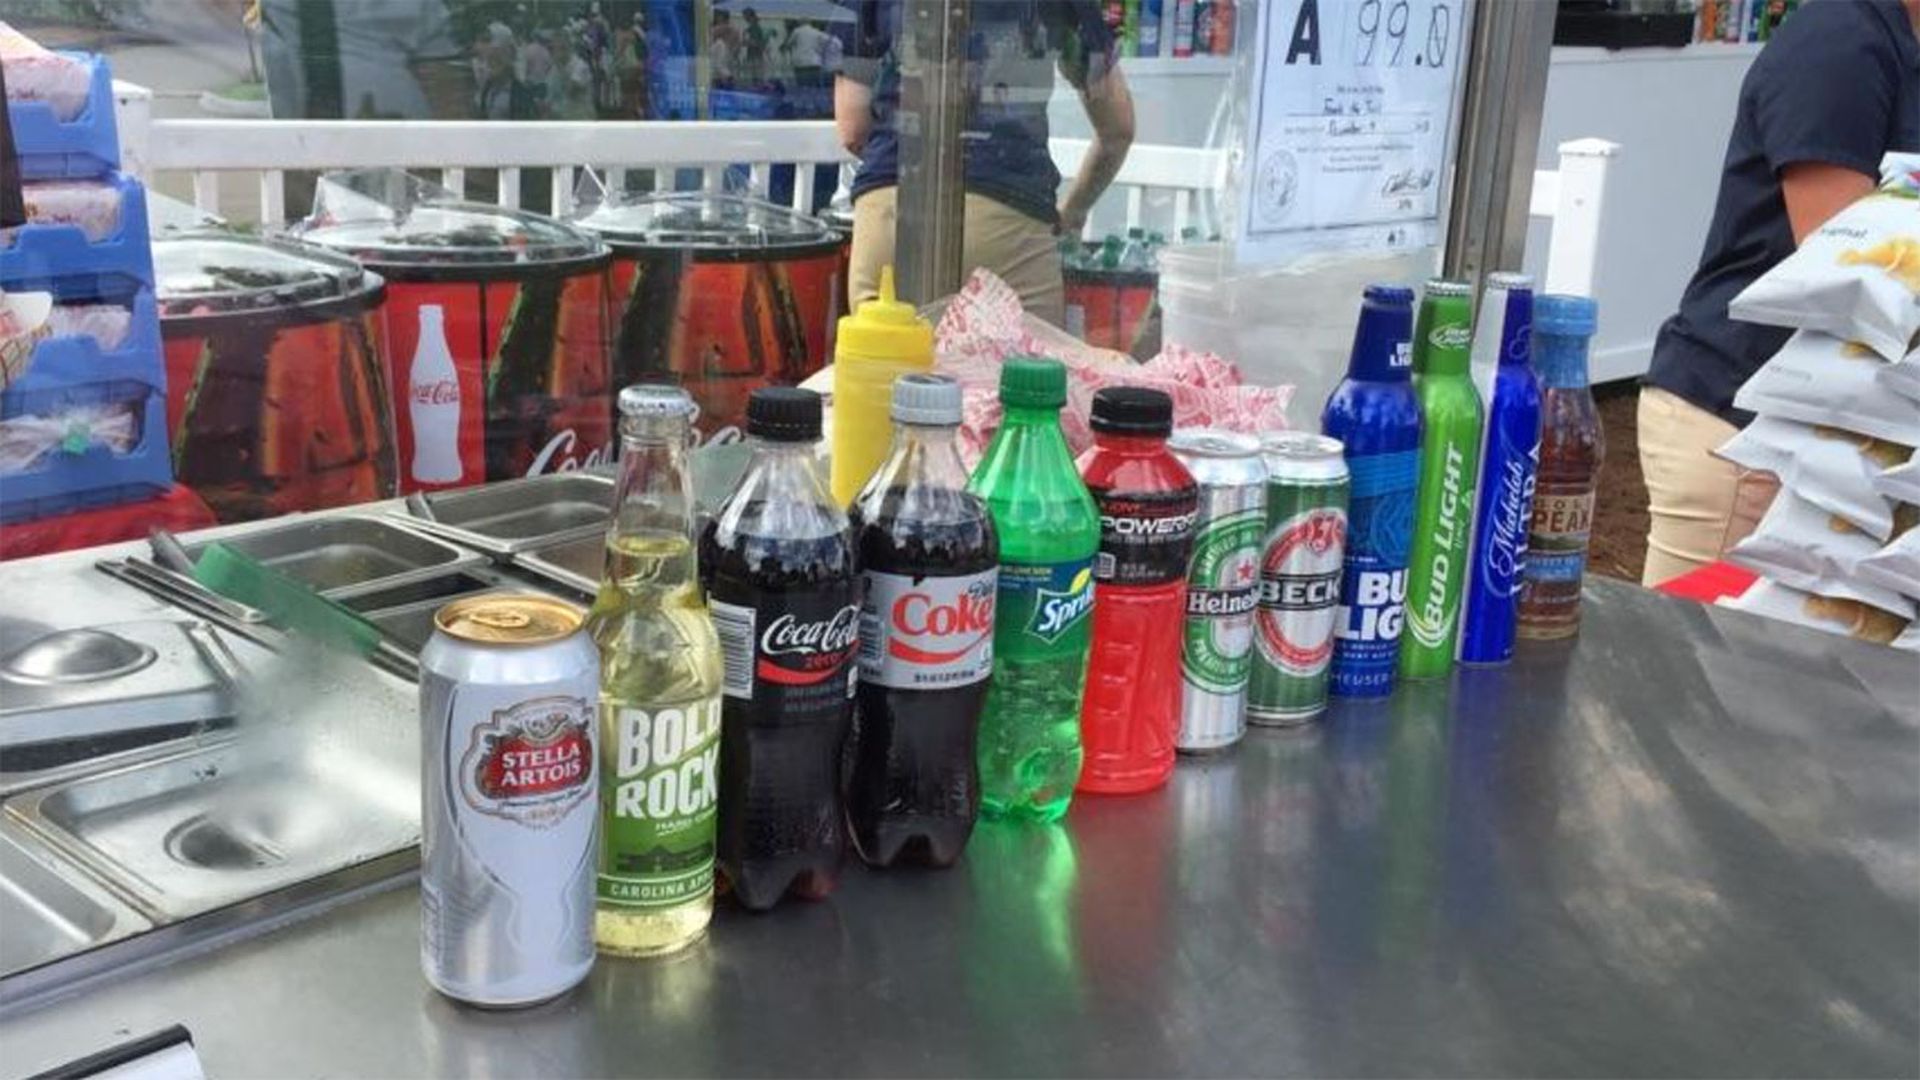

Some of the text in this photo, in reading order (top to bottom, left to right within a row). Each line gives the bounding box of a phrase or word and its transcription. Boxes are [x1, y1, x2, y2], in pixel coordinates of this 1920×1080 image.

[1285, 0, 1322, 65] A
[1358, 0, 1449, 68] 99.0
[1424, 441, 1463, 630] BUD LIGHT
[1488, 460, 1524, 577] Michelob
[892, 592, 994, 636] Coke
[502, 742, 581, 769] STELLA
[616, 698, 724, 779] BOLD
[501, 758, 582, 786] ARTOIS
[616, 741, 720, 819] ROCK
[610, 880, 685, 899] CAROLINA
